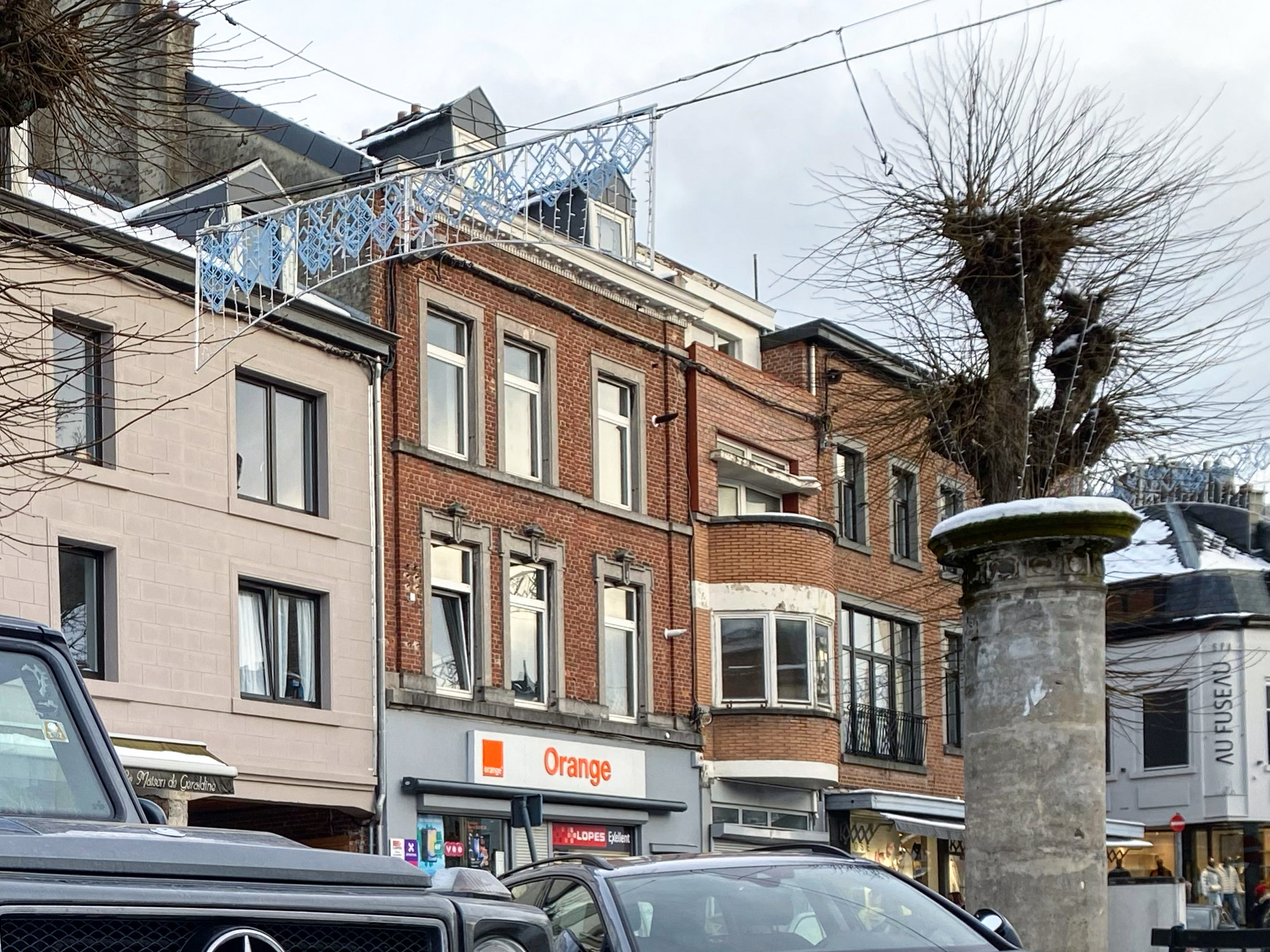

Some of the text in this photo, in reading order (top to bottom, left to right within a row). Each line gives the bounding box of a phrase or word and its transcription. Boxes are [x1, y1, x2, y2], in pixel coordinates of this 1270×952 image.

[1212, 661, 1233, 734] FUSEAU
[1215, 740, 1234, 765] AU
[543, 747, 612, 786] Orange
[136, 770, 166, 788] Maison
[168, 773, 178, 789] de
[576, 830, 606, 842] LOPES
